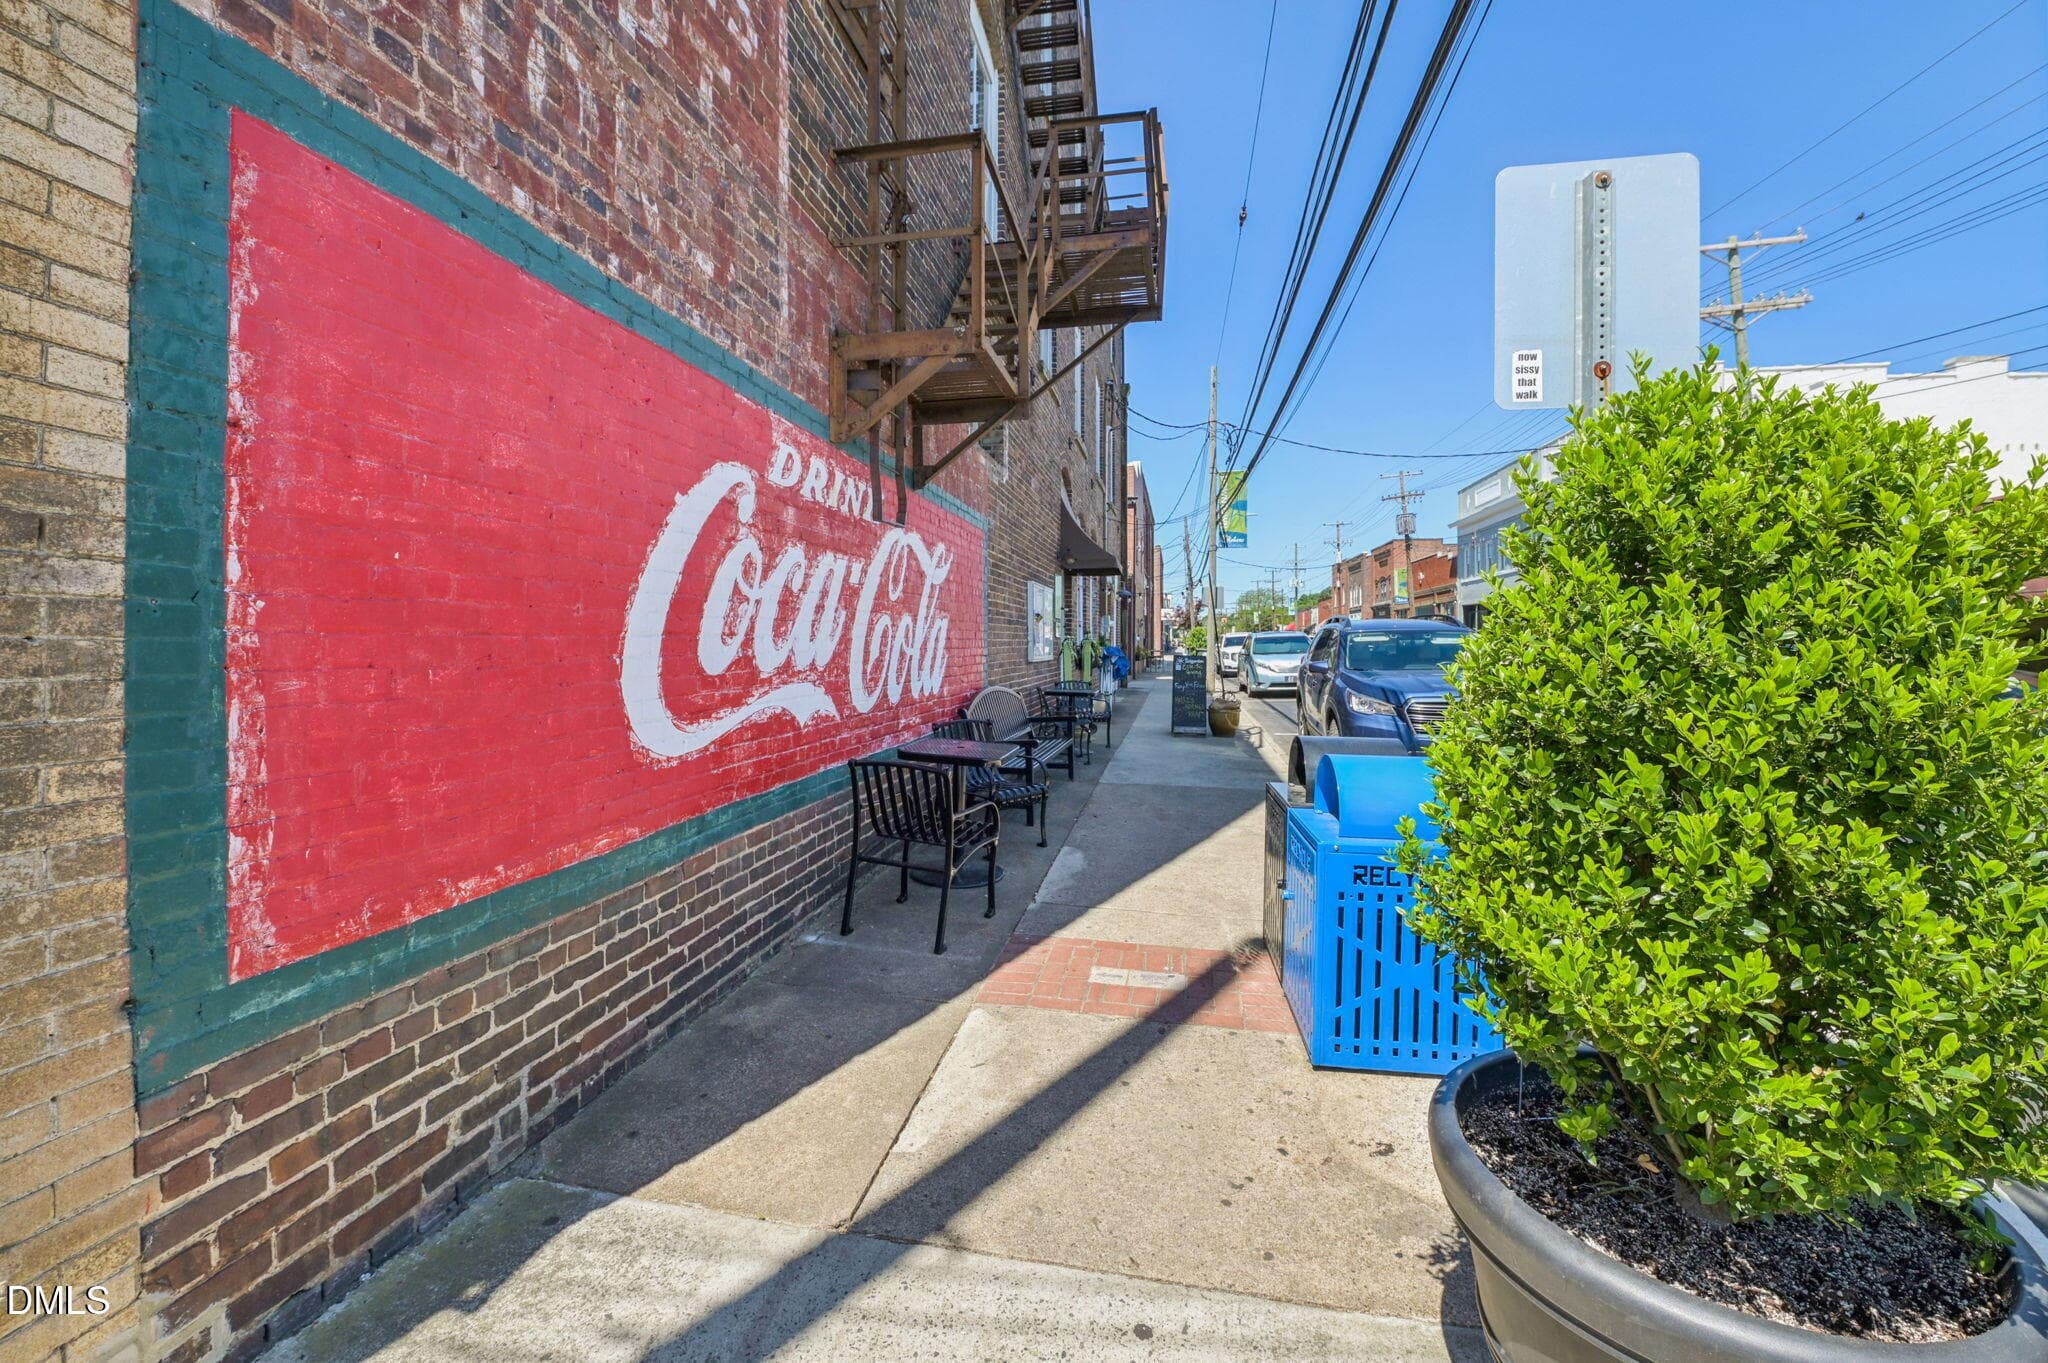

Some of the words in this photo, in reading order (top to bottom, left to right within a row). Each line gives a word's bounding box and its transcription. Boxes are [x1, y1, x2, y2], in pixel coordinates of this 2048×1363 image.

[1518, 353, 1537, 361] now
[1515, 365, 1539, 374] sissy
[1518, 378, 1536, 386] that
[1516, 390, 1537, 399] walk
[768, 442, 878, 523] DRIN
[1353, 866, 1430, 888] RECY
